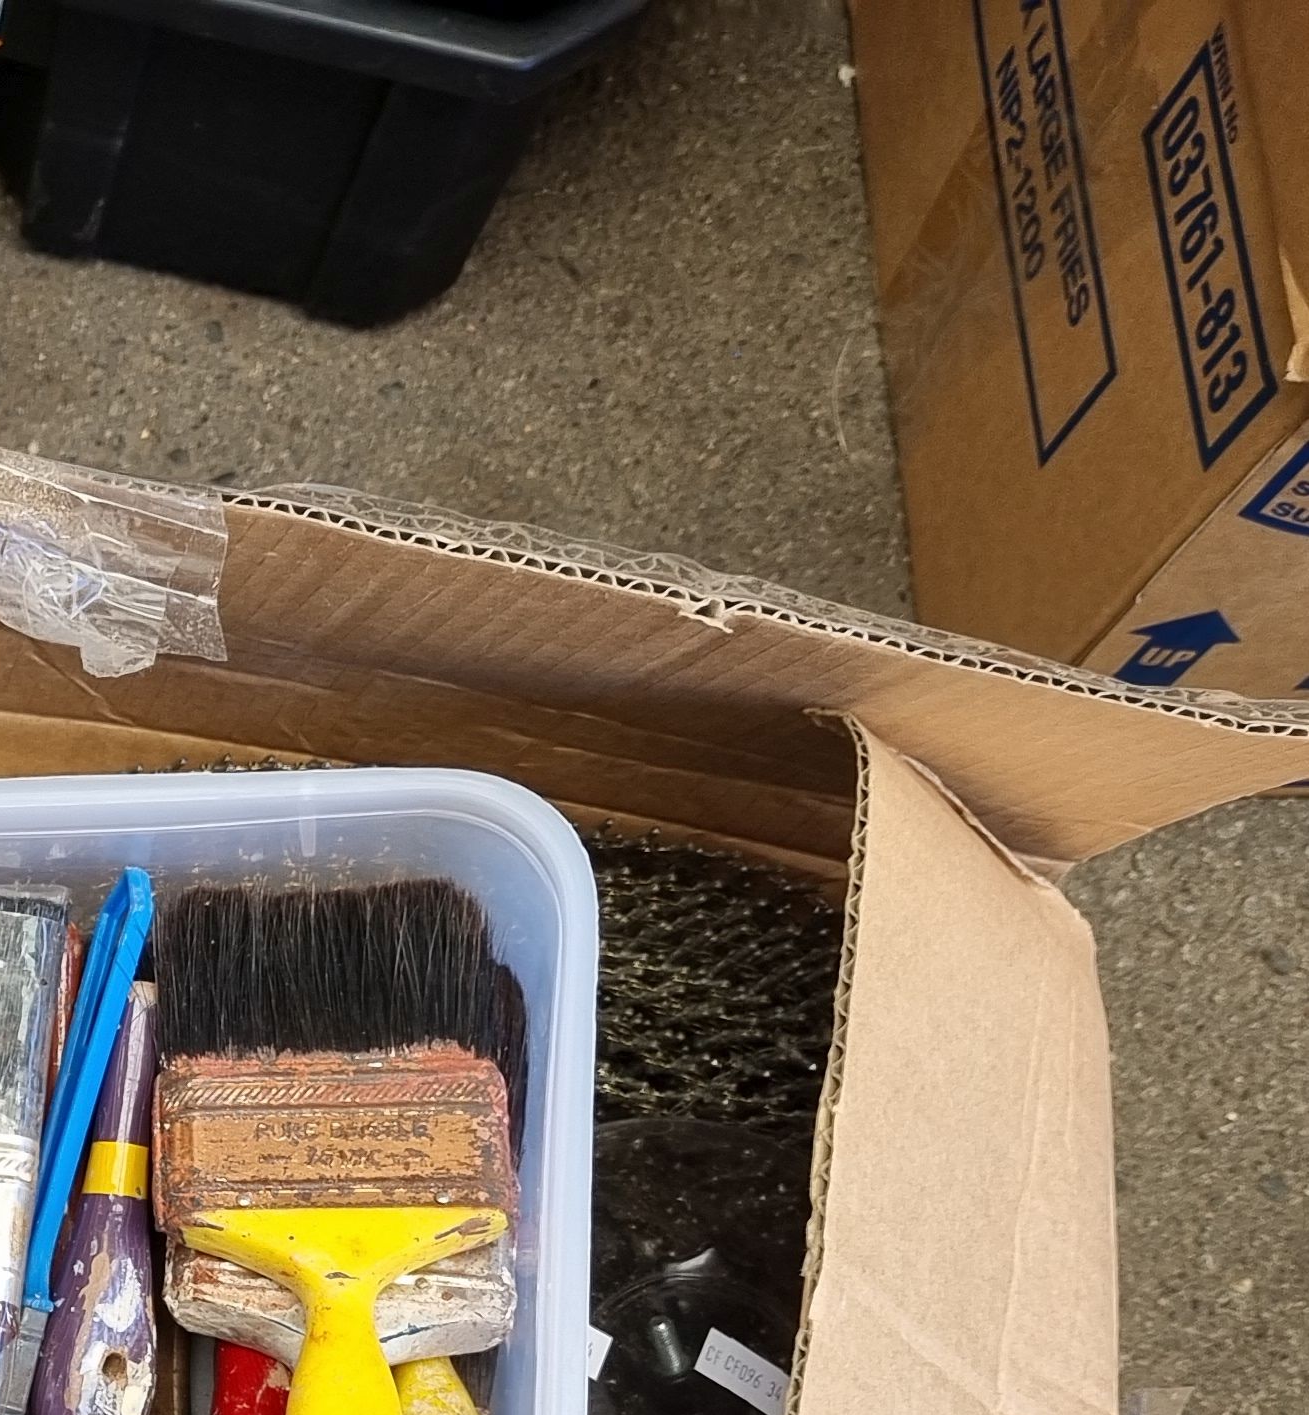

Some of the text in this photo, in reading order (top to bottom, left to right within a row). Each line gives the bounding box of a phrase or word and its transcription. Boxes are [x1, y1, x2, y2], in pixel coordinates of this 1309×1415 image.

[1028, 22, 1068, 192] LARGE
[1050, 183, 1090, 328] FRIES
[1162, 95, 1248, 413] 03761-813
[1138, 647, 1197, 677] UP
